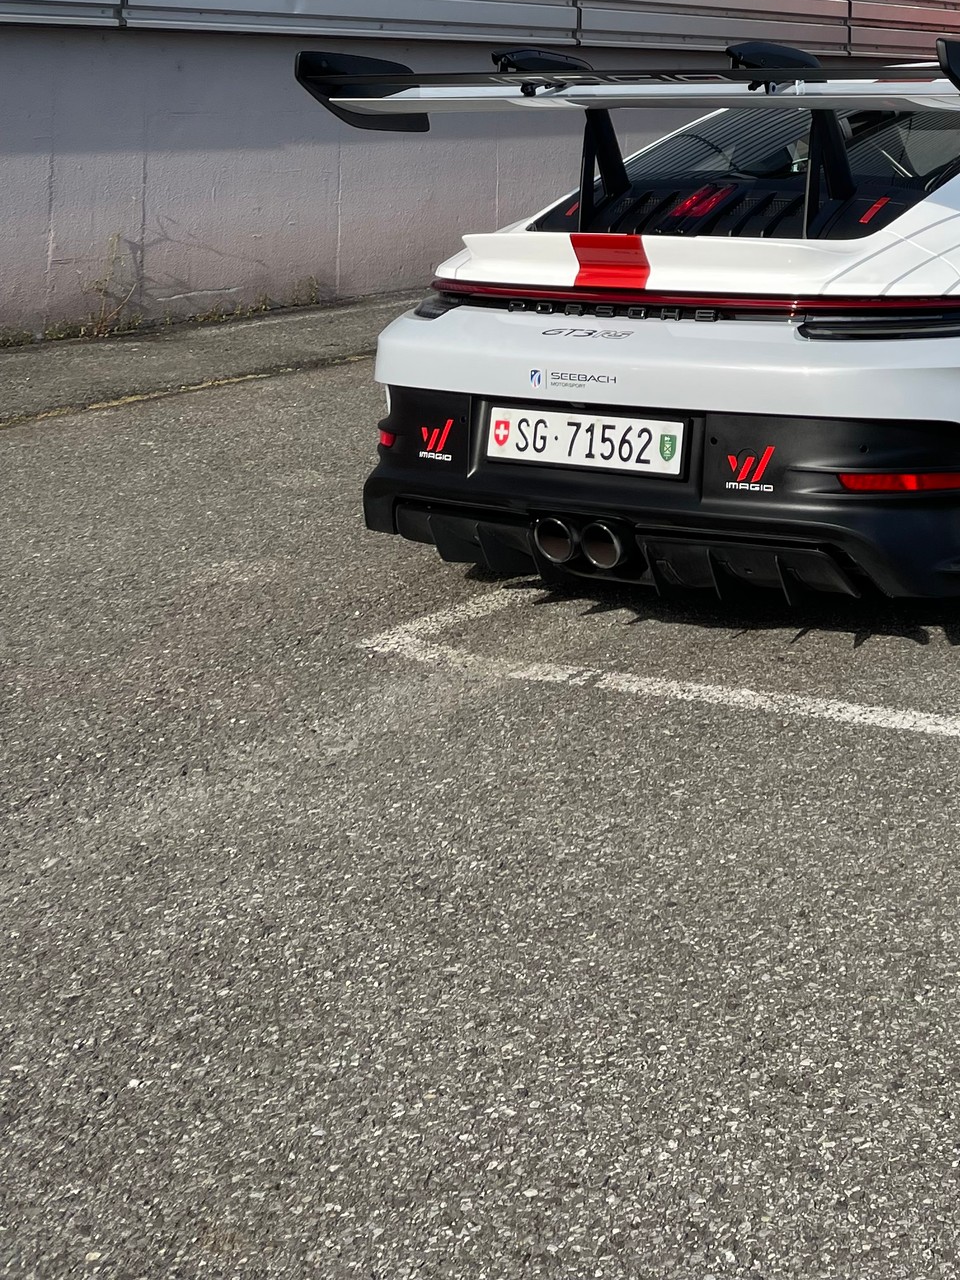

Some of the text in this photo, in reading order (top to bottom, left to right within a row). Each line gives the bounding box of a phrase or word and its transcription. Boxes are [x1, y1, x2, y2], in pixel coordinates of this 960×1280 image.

[507, 300, 717, 322] PORSCHE
[550, 371, 618, 384] SEEBACH
[550, 381, 586, 389] MOTORSPORT
[418, 451, 453, 462] IMAGIO
[725, 481, 774, 492] IMAGIO
